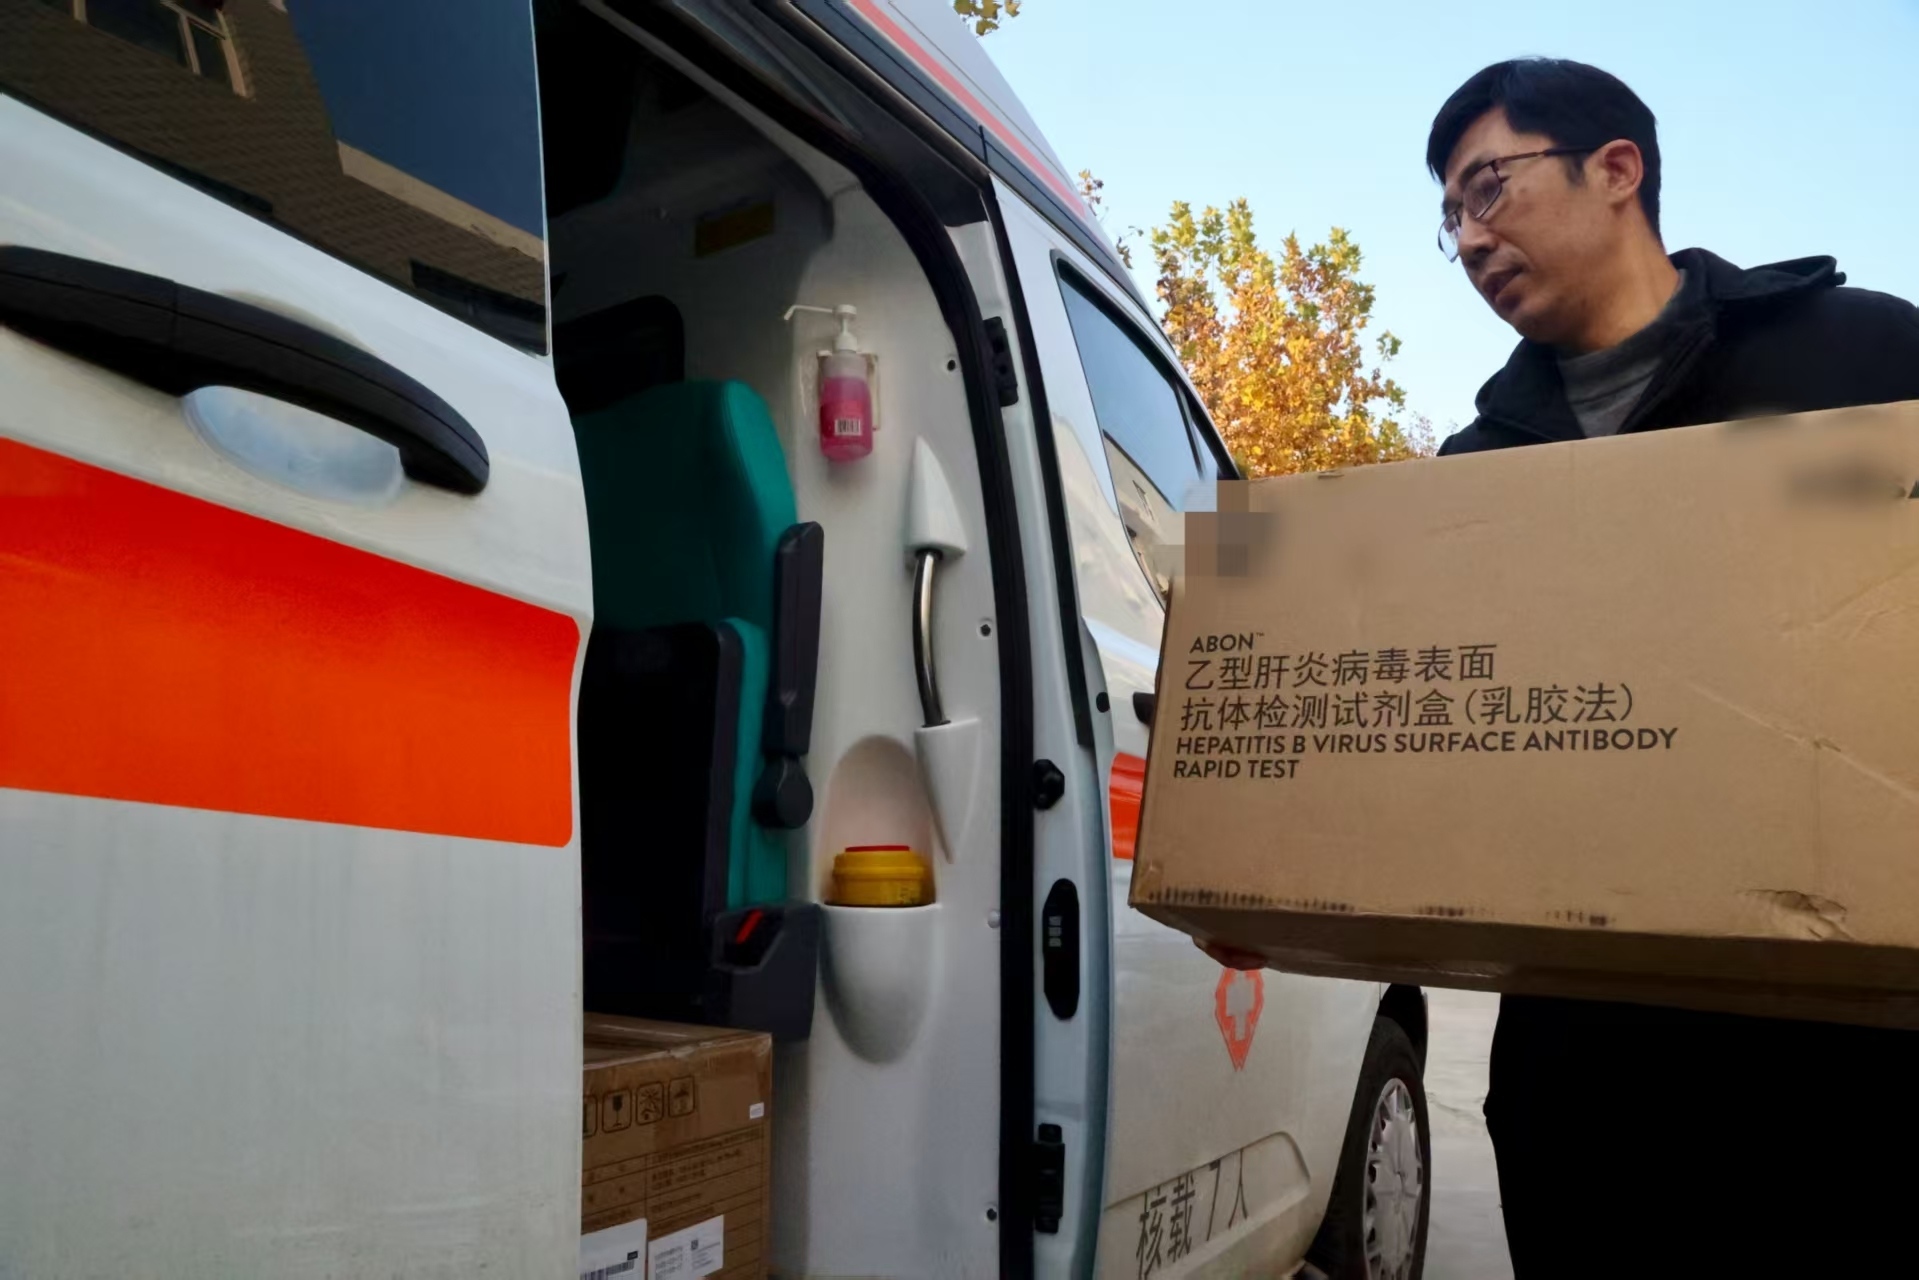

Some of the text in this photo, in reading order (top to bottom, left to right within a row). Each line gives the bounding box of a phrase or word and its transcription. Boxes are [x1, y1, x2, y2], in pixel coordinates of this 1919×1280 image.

[1185, 643, 1498, 690] 乙型肝炎病毒表面
[1176, 727, 1678, 756] HEPATITIS B VIRUS SURFACE ANTIBODY
[1173, 759, 1300, 779] RAPID TEST
